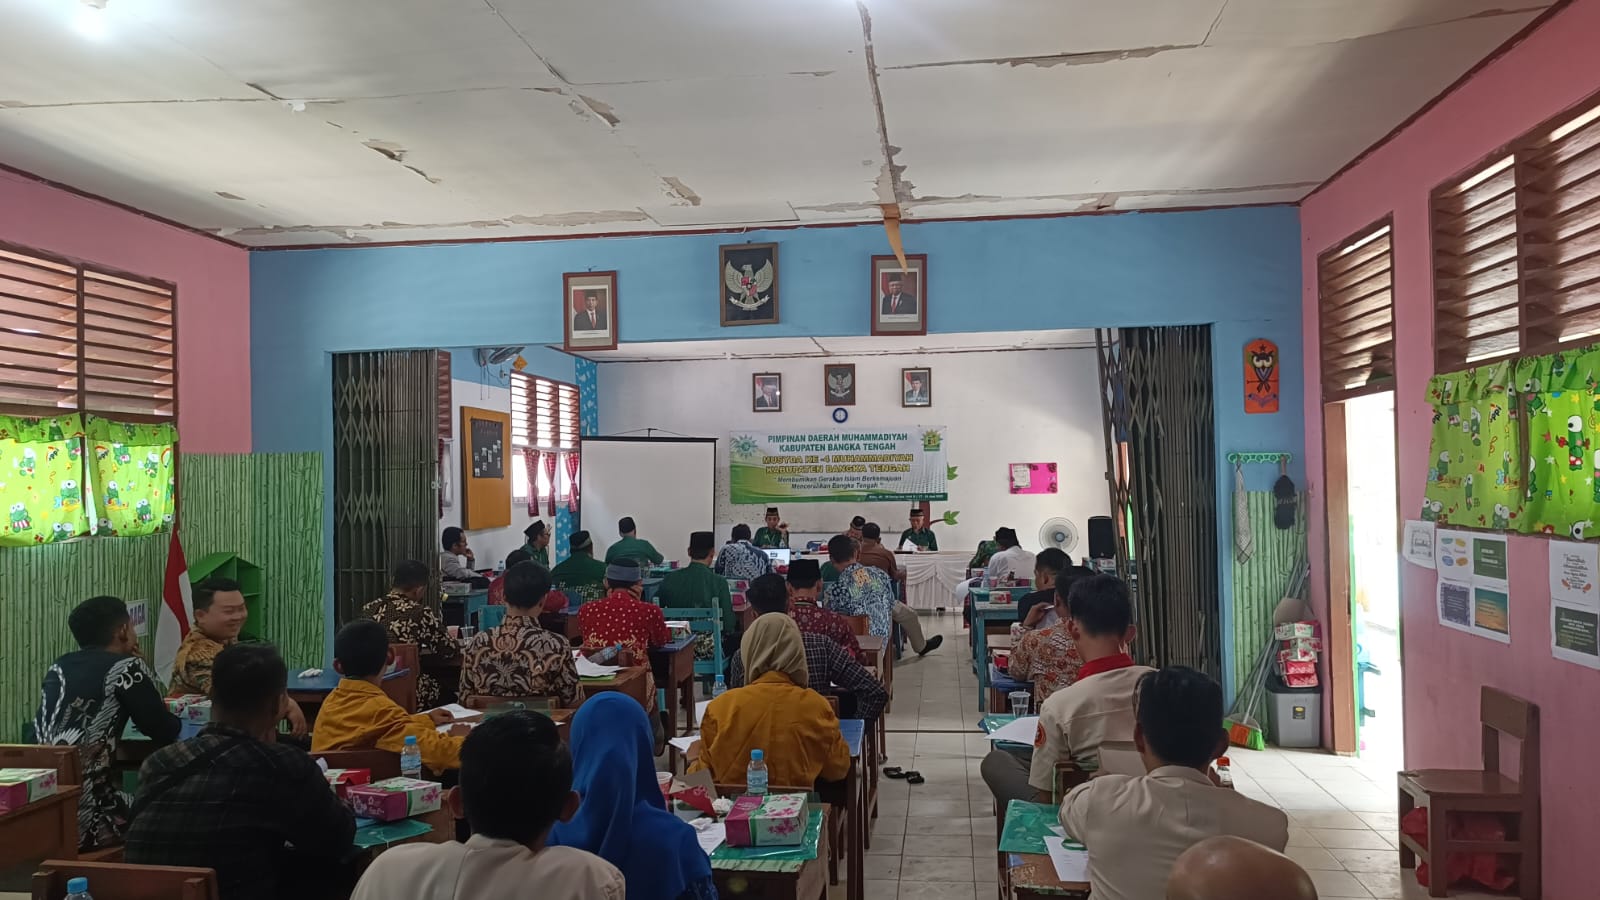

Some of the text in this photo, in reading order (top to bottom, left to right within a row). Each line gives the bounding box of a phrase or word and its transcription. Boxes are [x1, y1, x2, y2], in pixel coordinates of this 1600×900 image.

[767, 433, 908, 443] PIMPINAN DAERAH MUHAMMADIYAH
[779, 442, 896, 453] KABUPATEN BANGKA TENGAH
[832, 453, 914, 463] MUHAMMADIYAH
[765, 463, 911, 475] KABUPATEN BANGKA TENGAH
